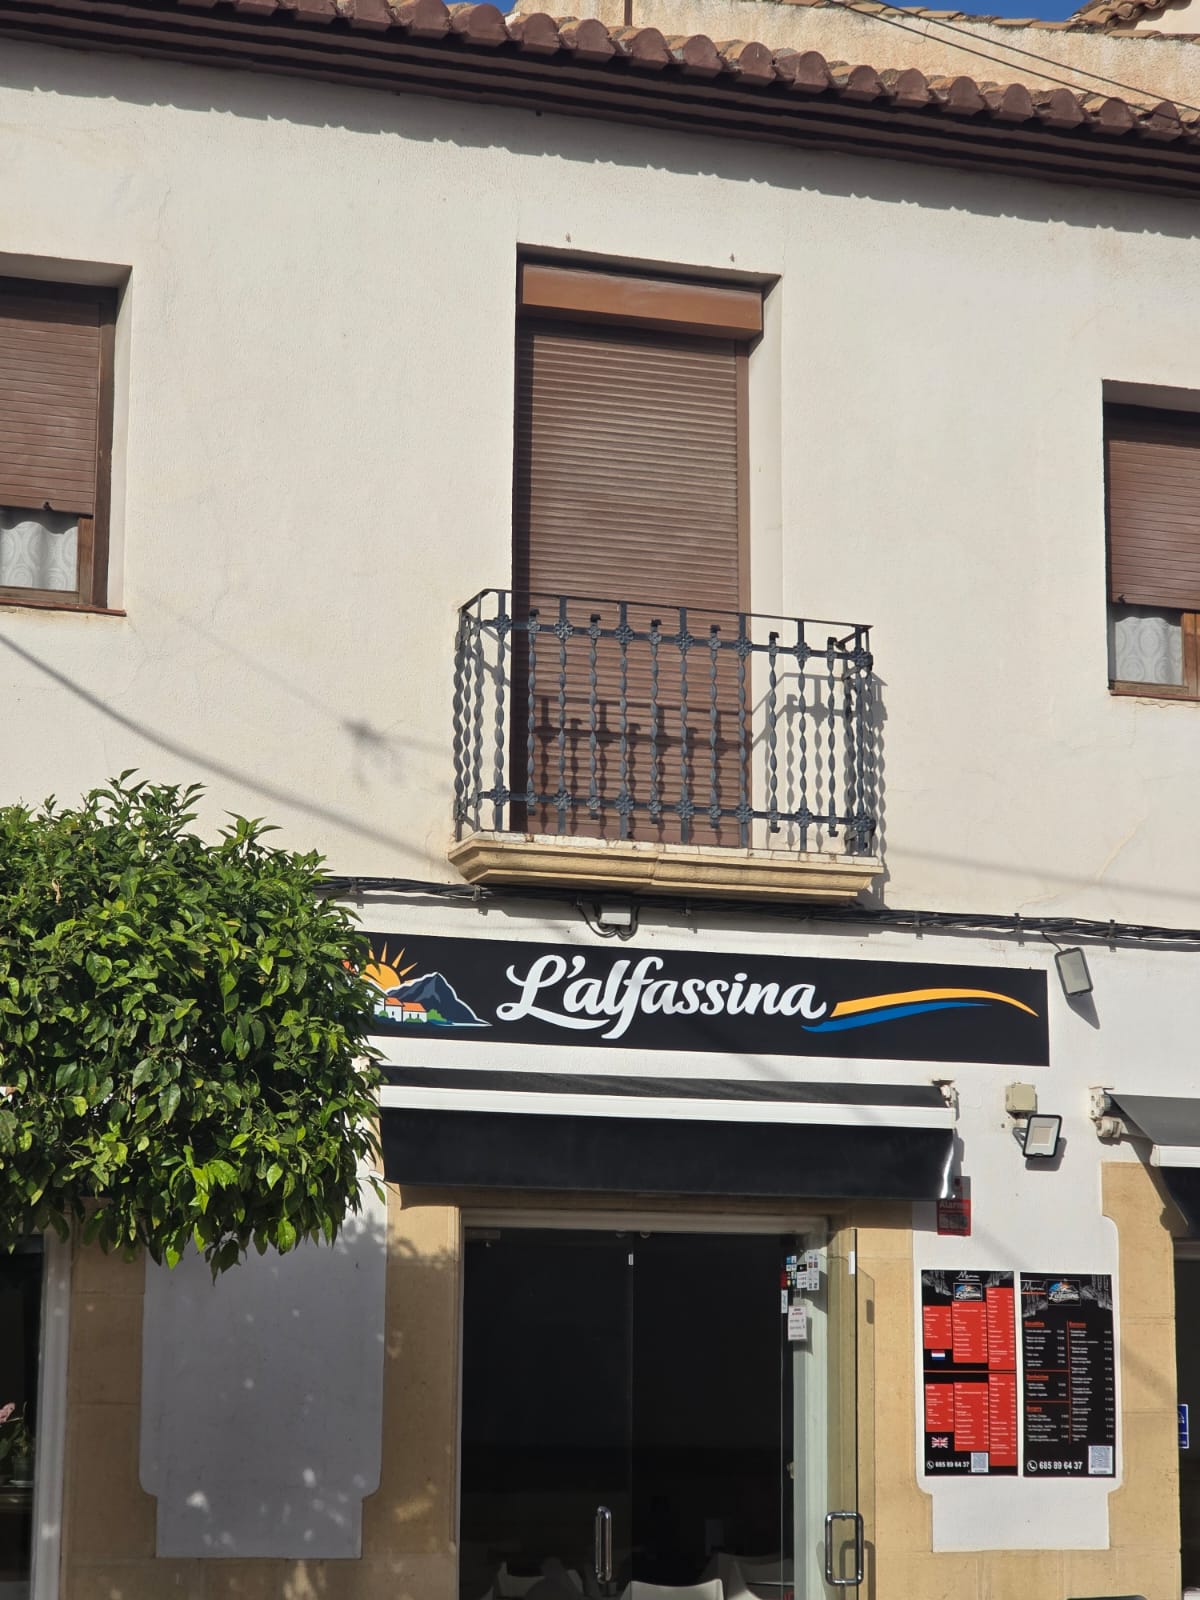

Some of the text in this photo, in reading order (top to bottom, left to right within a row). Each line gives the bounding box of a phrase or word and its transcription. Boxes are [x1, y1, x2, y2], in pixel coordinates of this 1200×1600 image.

[495, 953, 827, 1040] L'alfassina
[1039, 1461, 1083, 1470] 685 89 64 37
